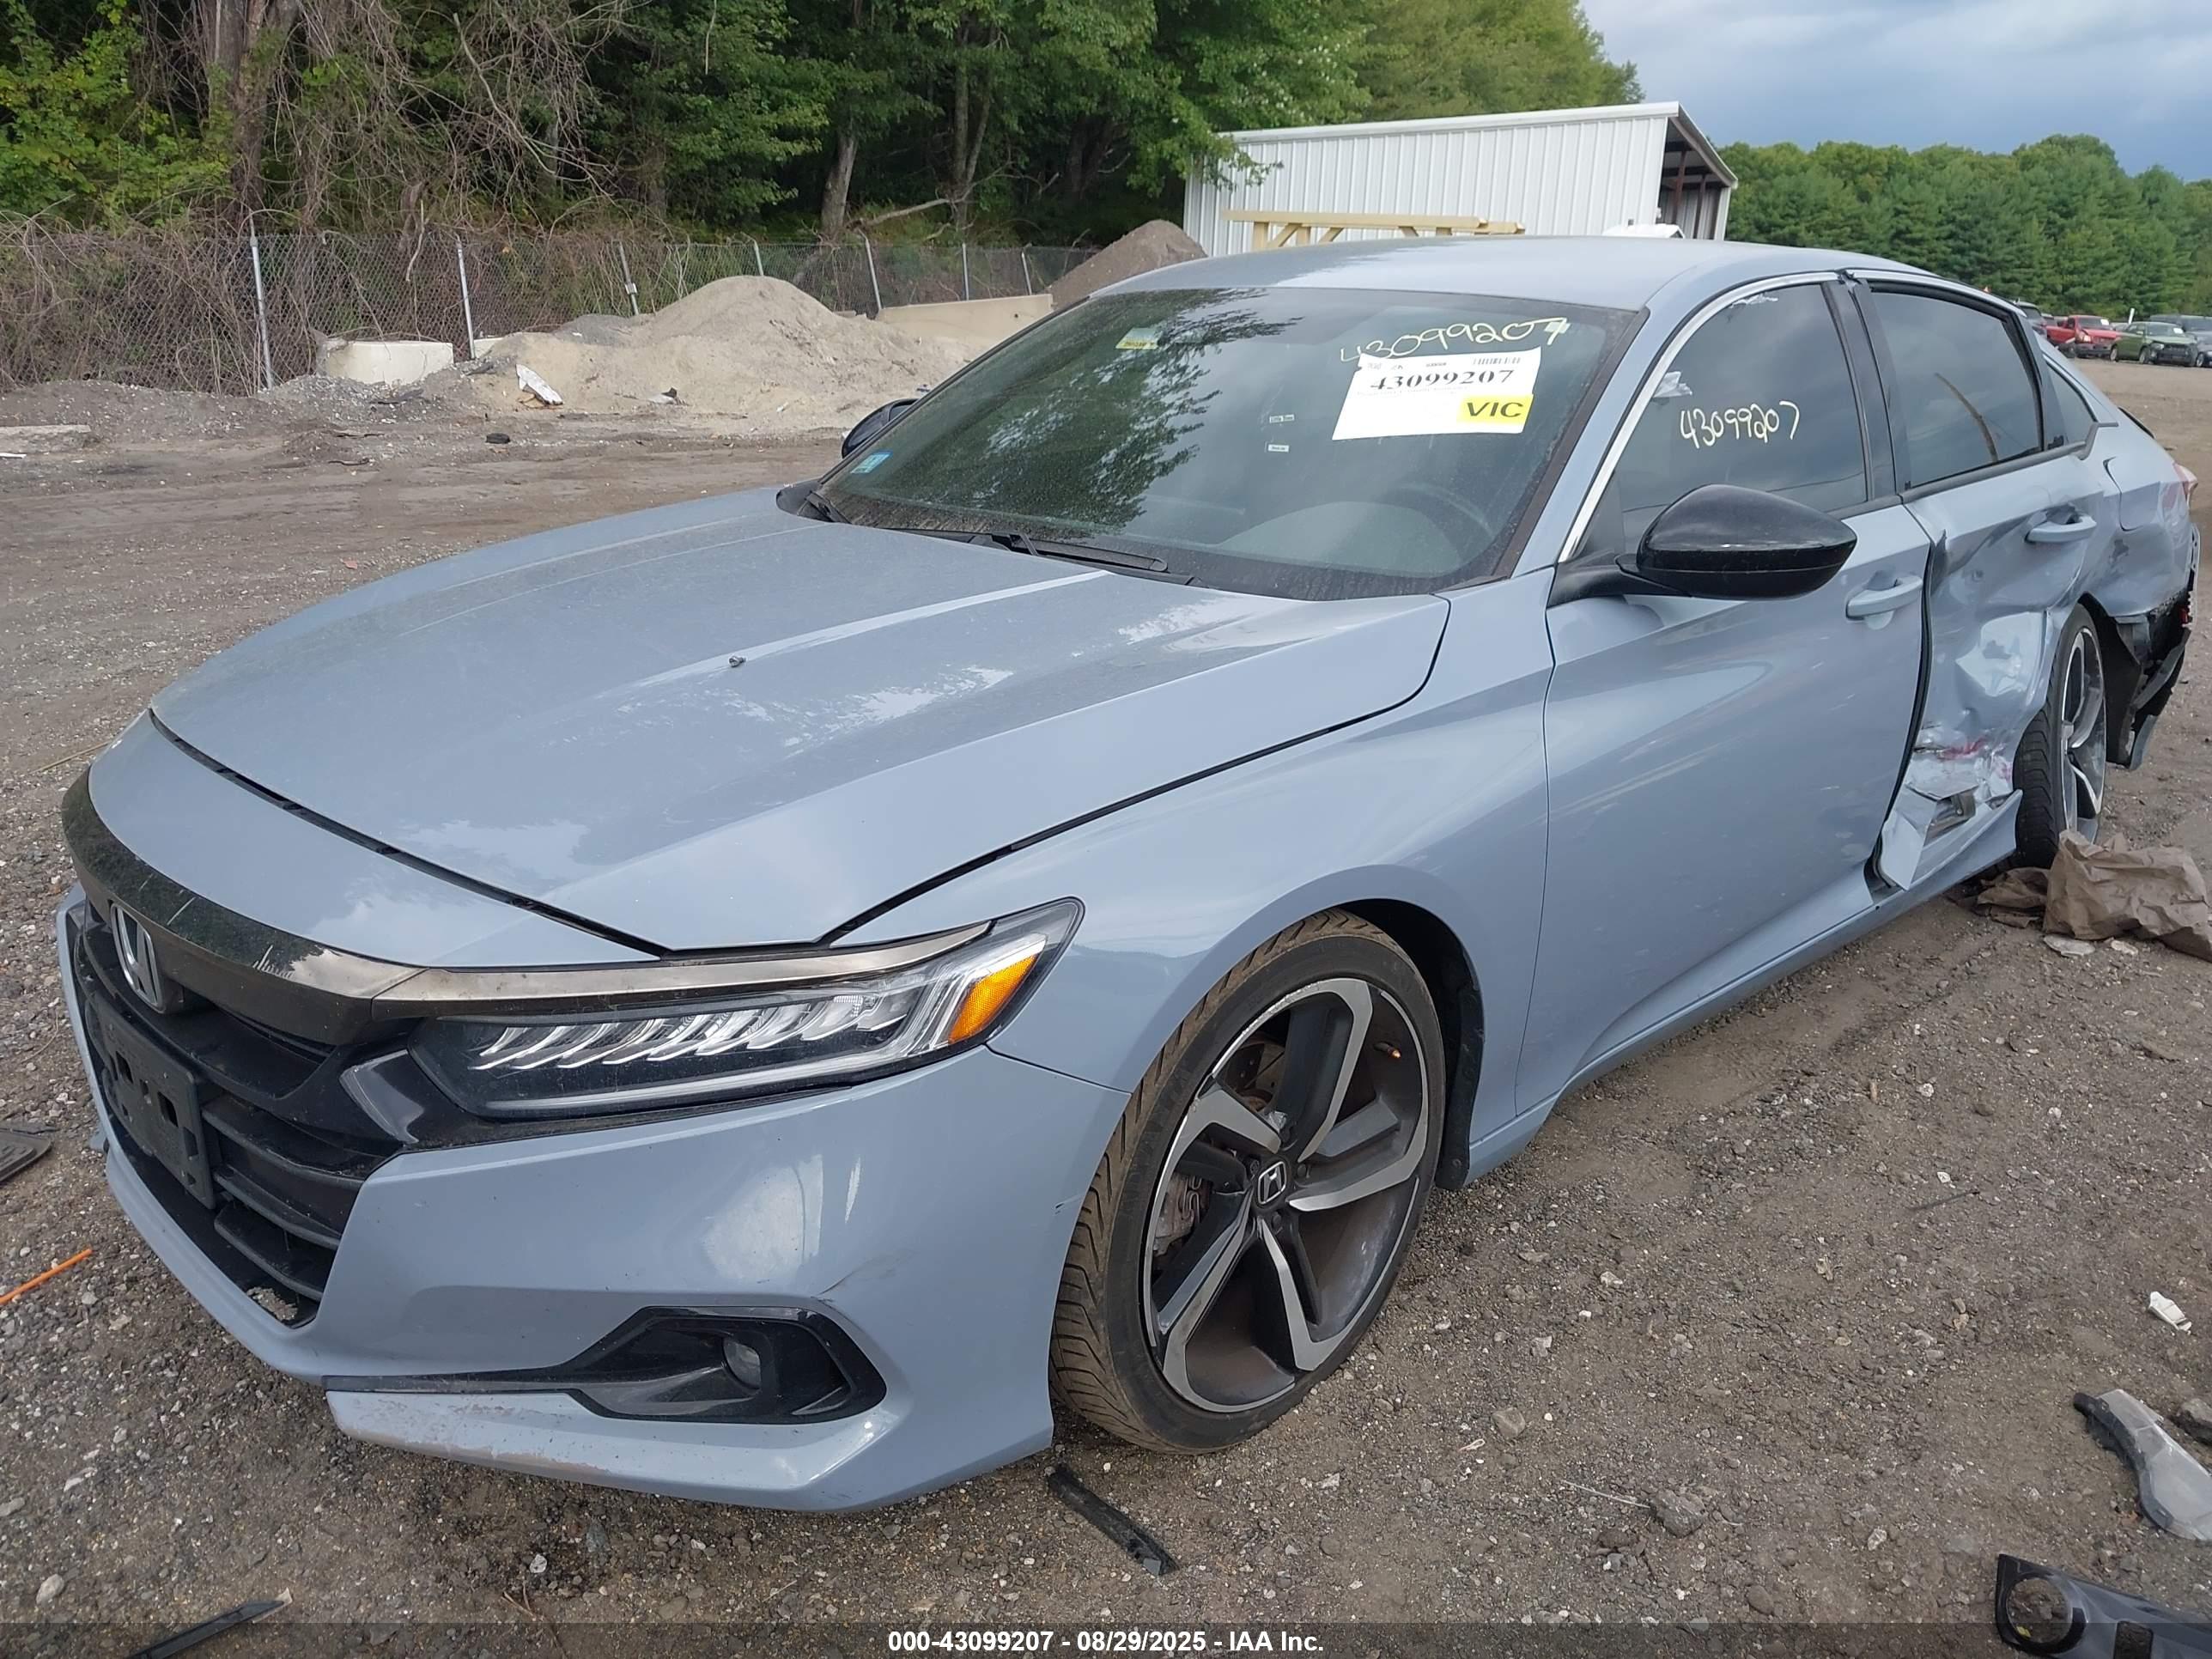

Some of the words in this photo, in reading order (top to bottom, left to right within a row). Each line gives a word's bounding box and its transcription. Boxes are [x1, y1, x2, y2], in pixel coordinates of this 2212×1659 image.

[1340, 316, 1568, 363] 43099207
[1370, 368, 1515, 391] 43099207
[1466, 401, 1524, 418] VIC
[1680, 399, 1801, 450] 43099207
